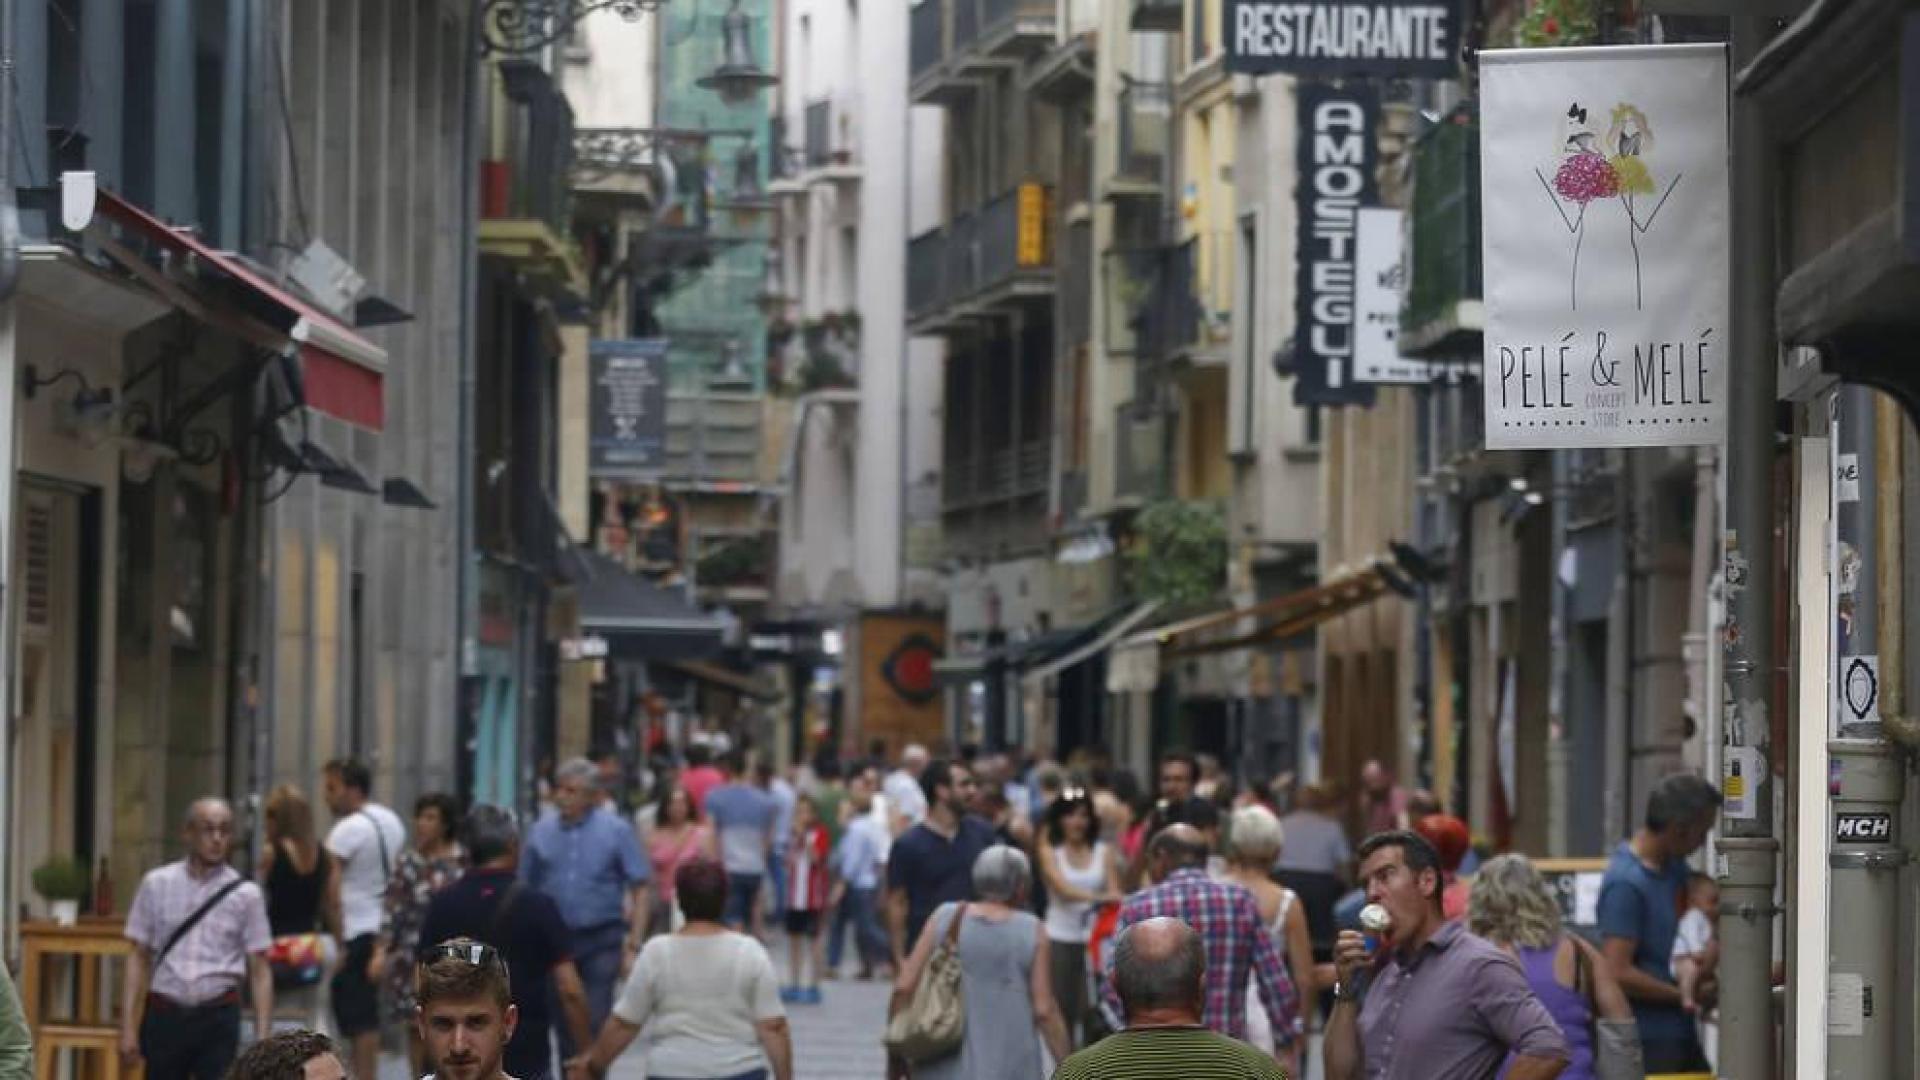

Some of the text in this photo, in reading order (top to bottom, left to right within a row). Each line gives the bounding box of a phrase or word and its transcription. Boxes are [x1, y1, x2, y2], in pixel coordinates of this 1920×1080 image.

[1235, 4, 1448, 58] RESTAURANTE
[1312, 102, 1363, 388] AMOSTEGUI
[1500, 328, 1713, 408] PELÉ & MELÉ
[1837, 819, 1889, 836] MCH
